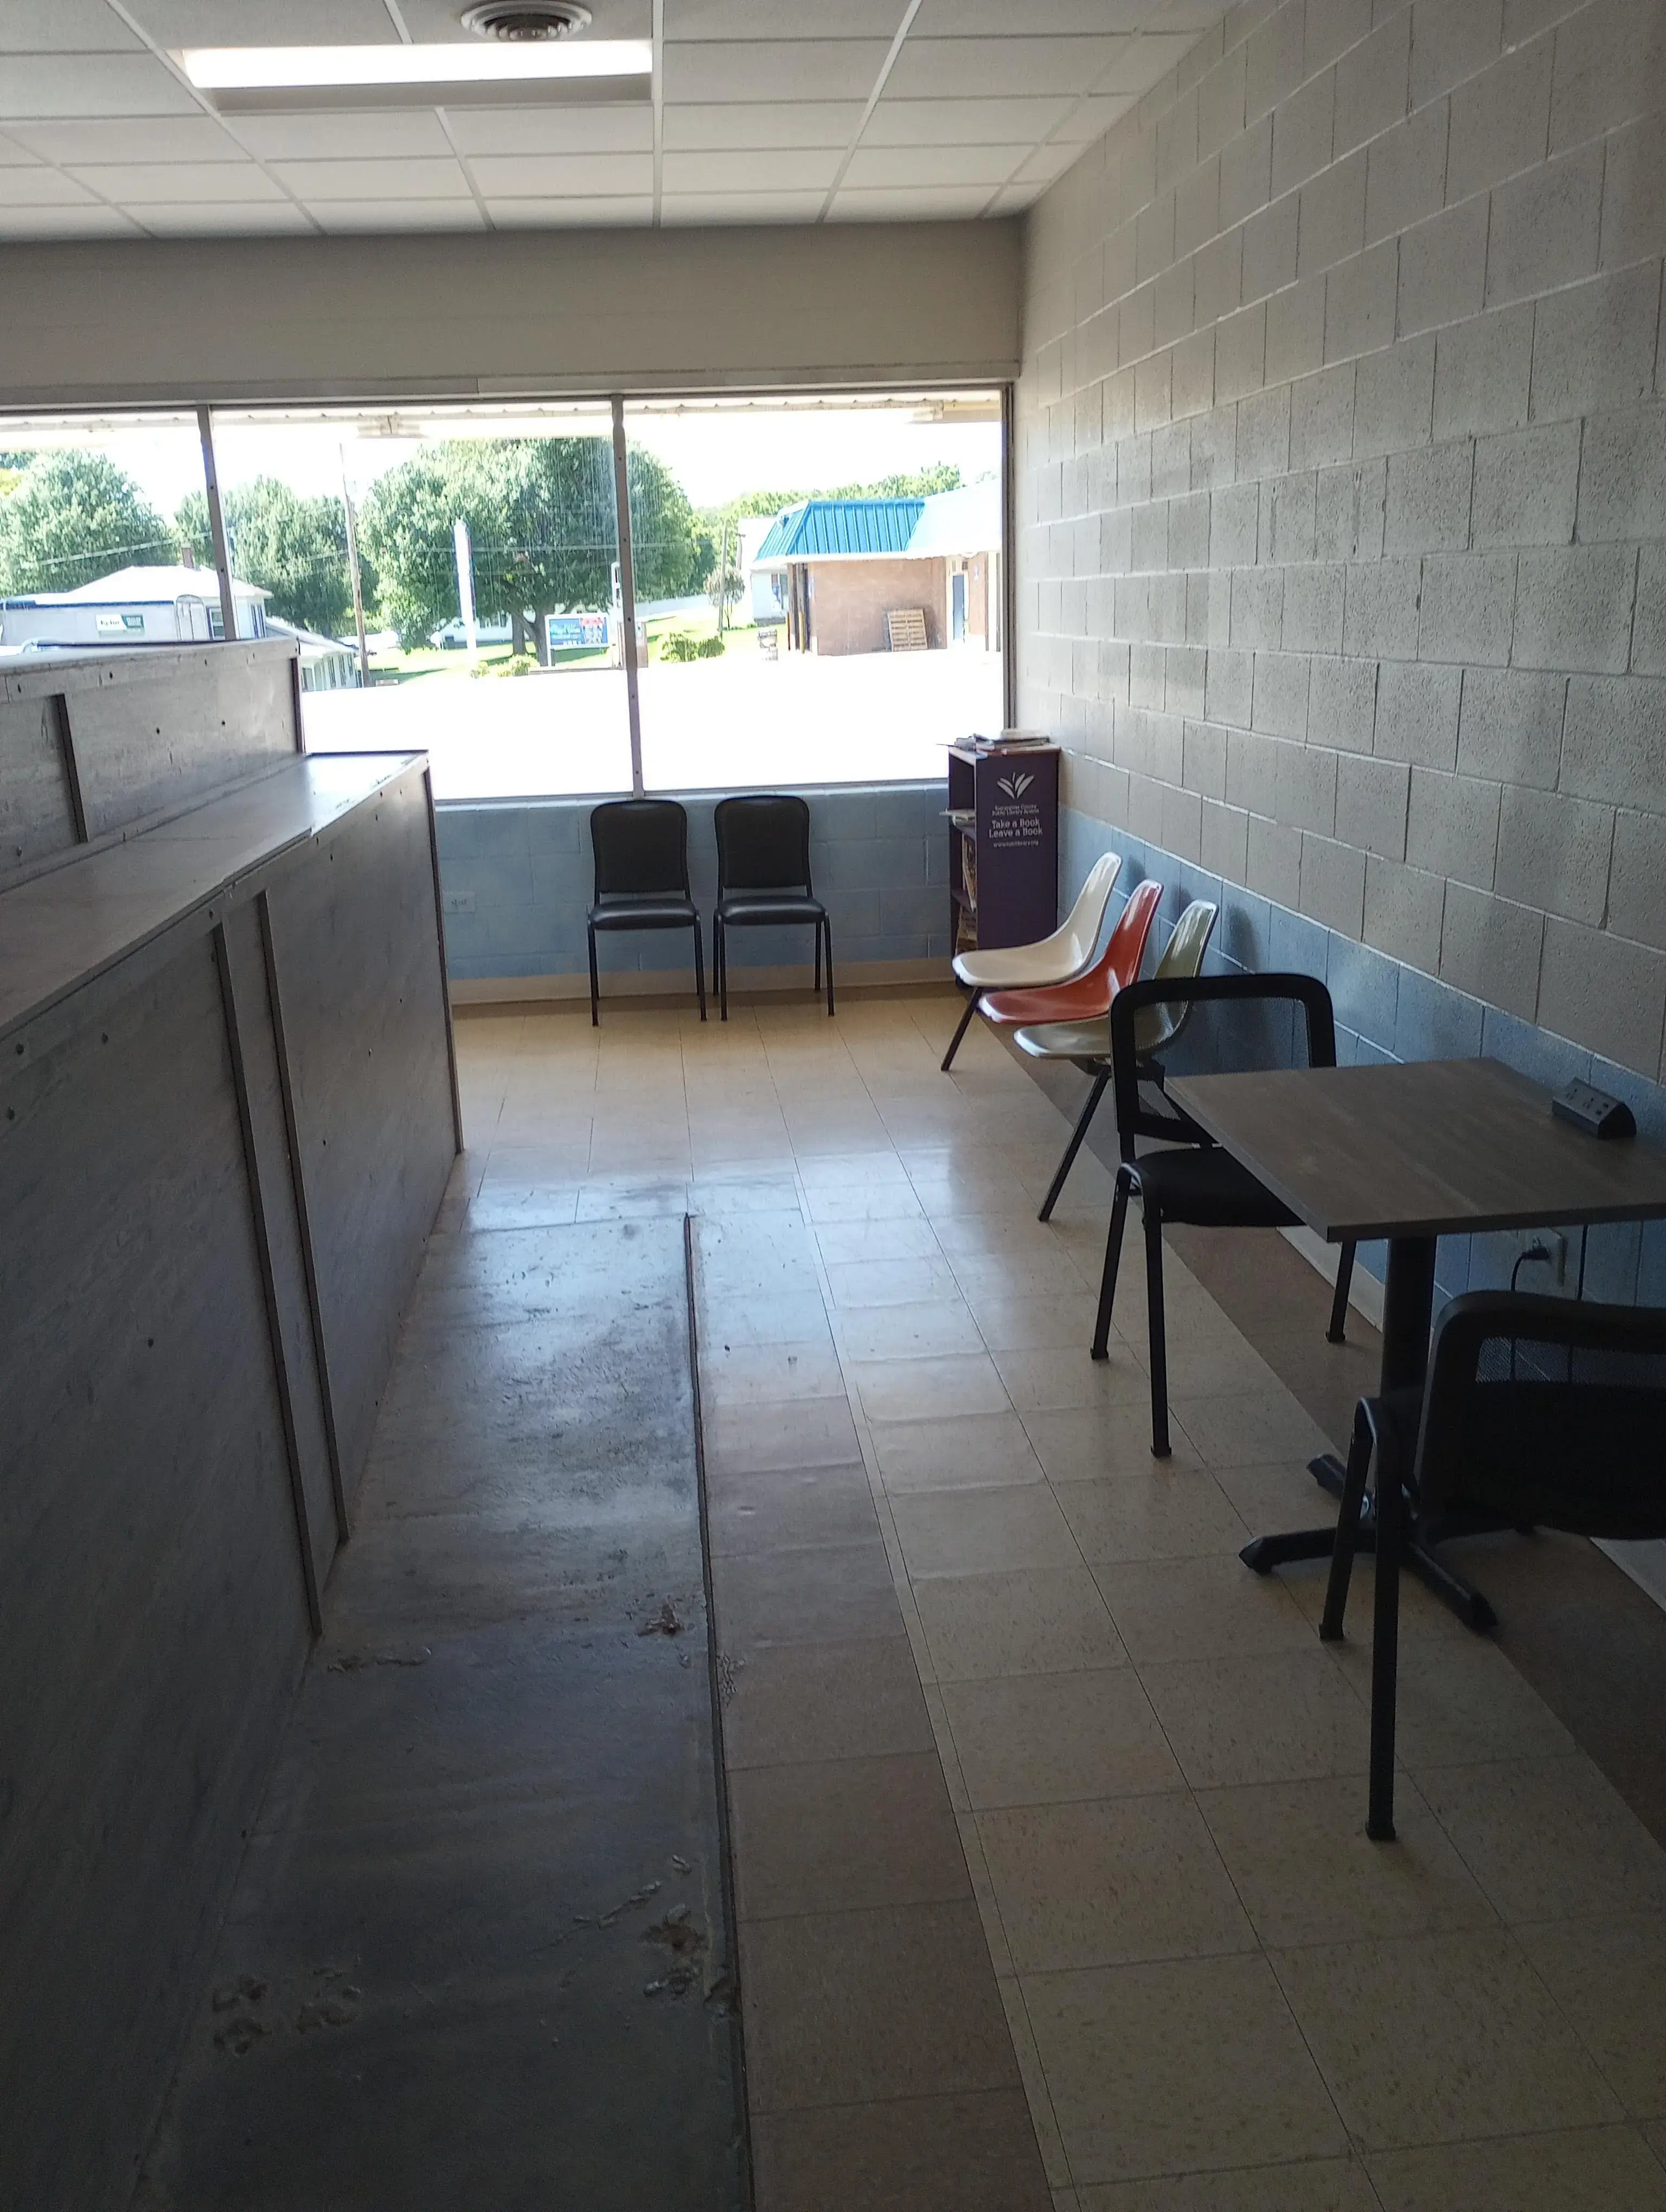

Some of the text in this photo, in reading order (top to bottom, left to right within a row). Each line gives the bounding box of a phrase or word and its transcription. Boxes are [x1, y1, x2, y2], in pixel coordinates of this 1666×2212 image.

[991, 817, 1040, 829] Take a Book
[989, 827, 1043, 838] Leave a Book
